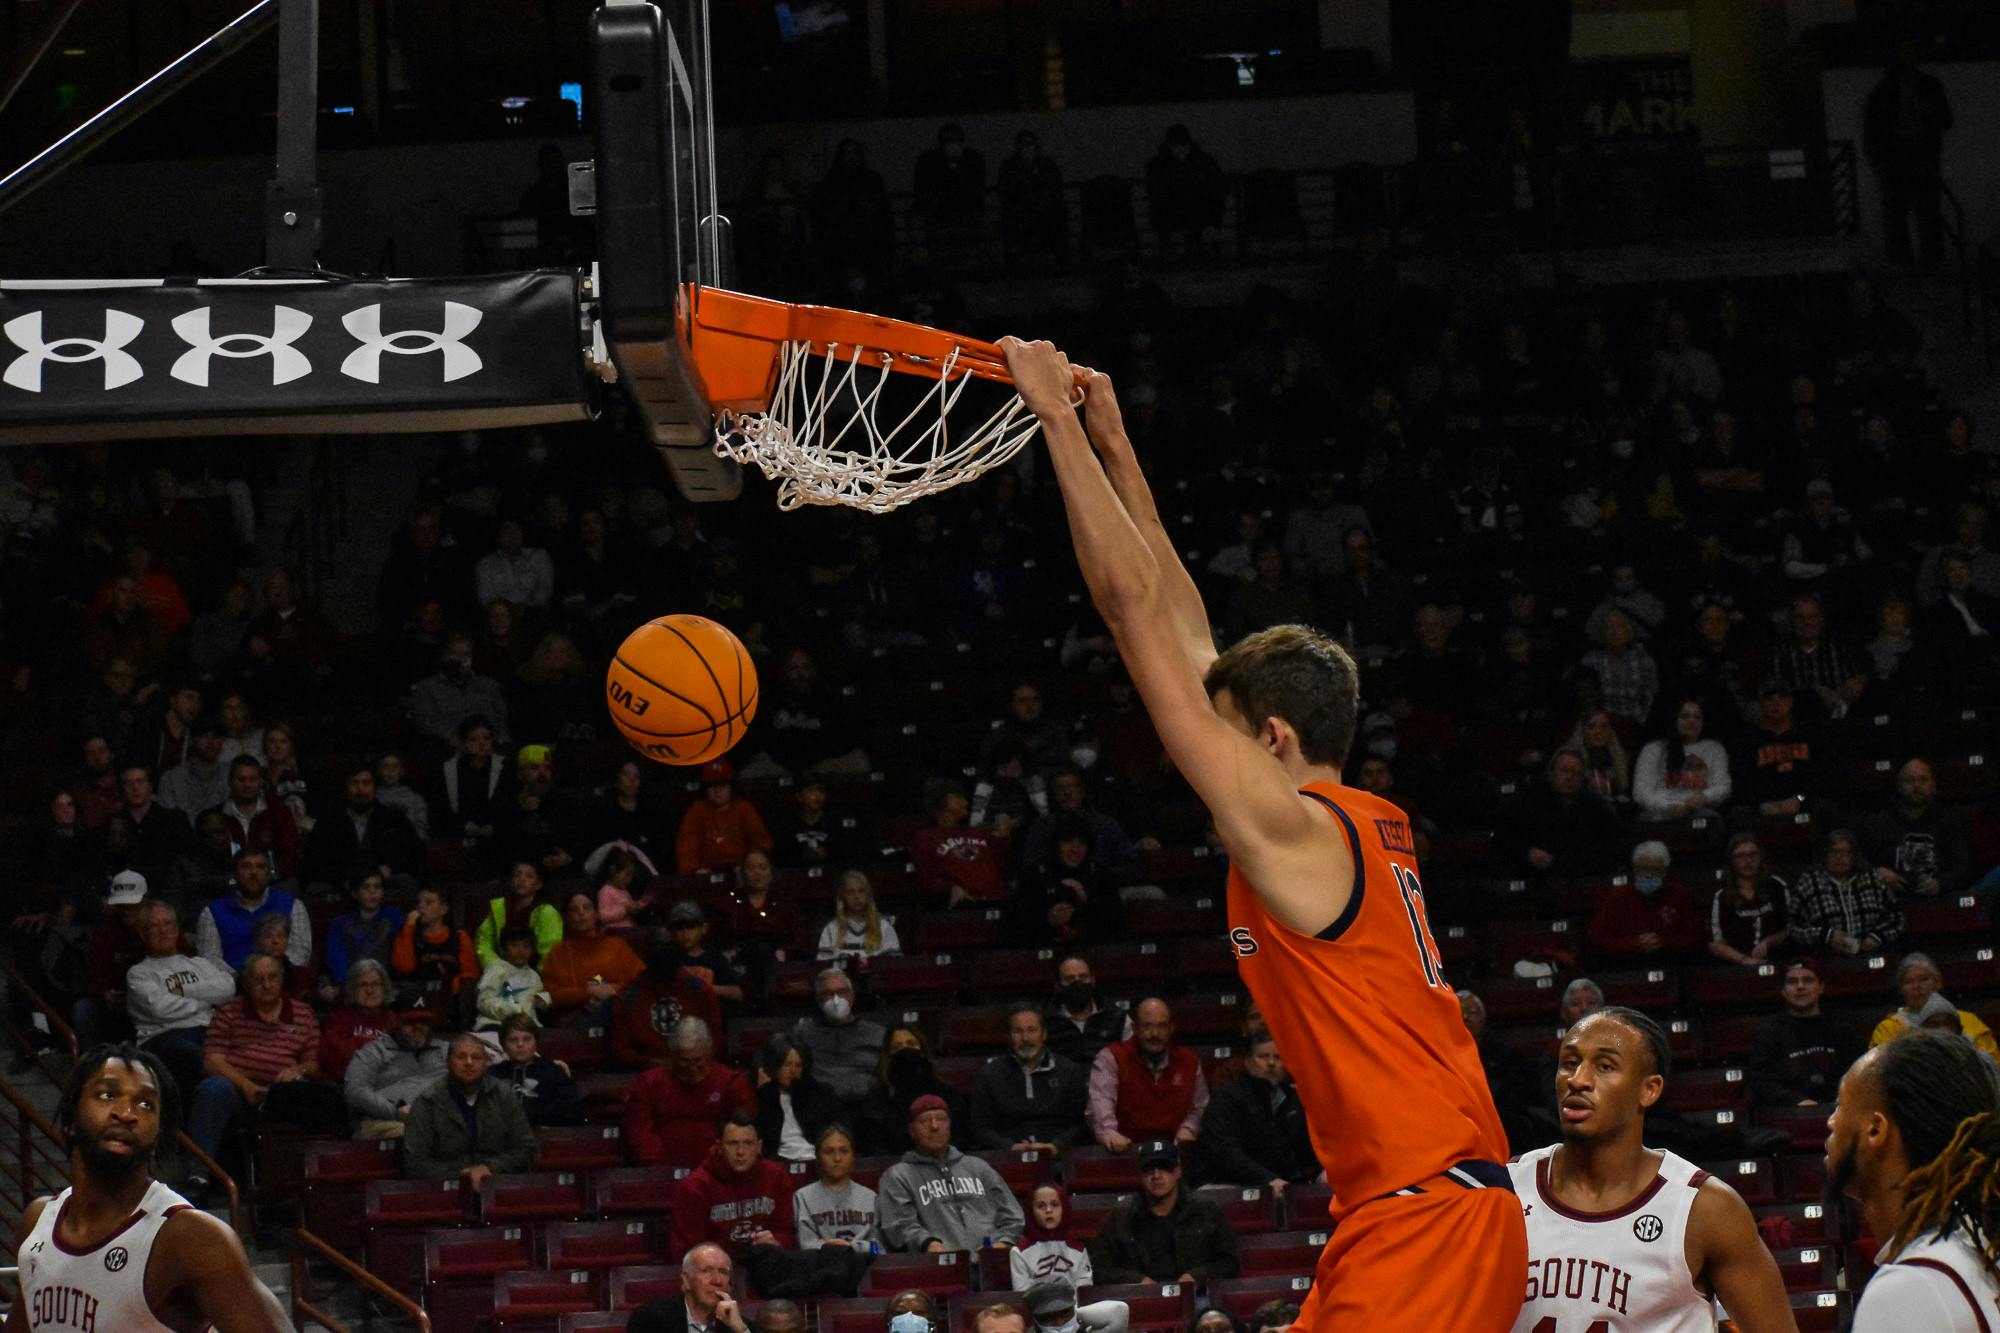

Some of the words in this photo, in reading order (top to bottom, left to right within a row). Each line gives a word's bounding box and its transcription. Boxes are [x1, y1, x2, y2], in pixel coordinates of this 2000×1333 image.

[1635, 1216, 1661, 1240] SEC
[33, 1286, 98, 1333] SOUTH
[1525, 1258, 1631, 1315] SOUTH
